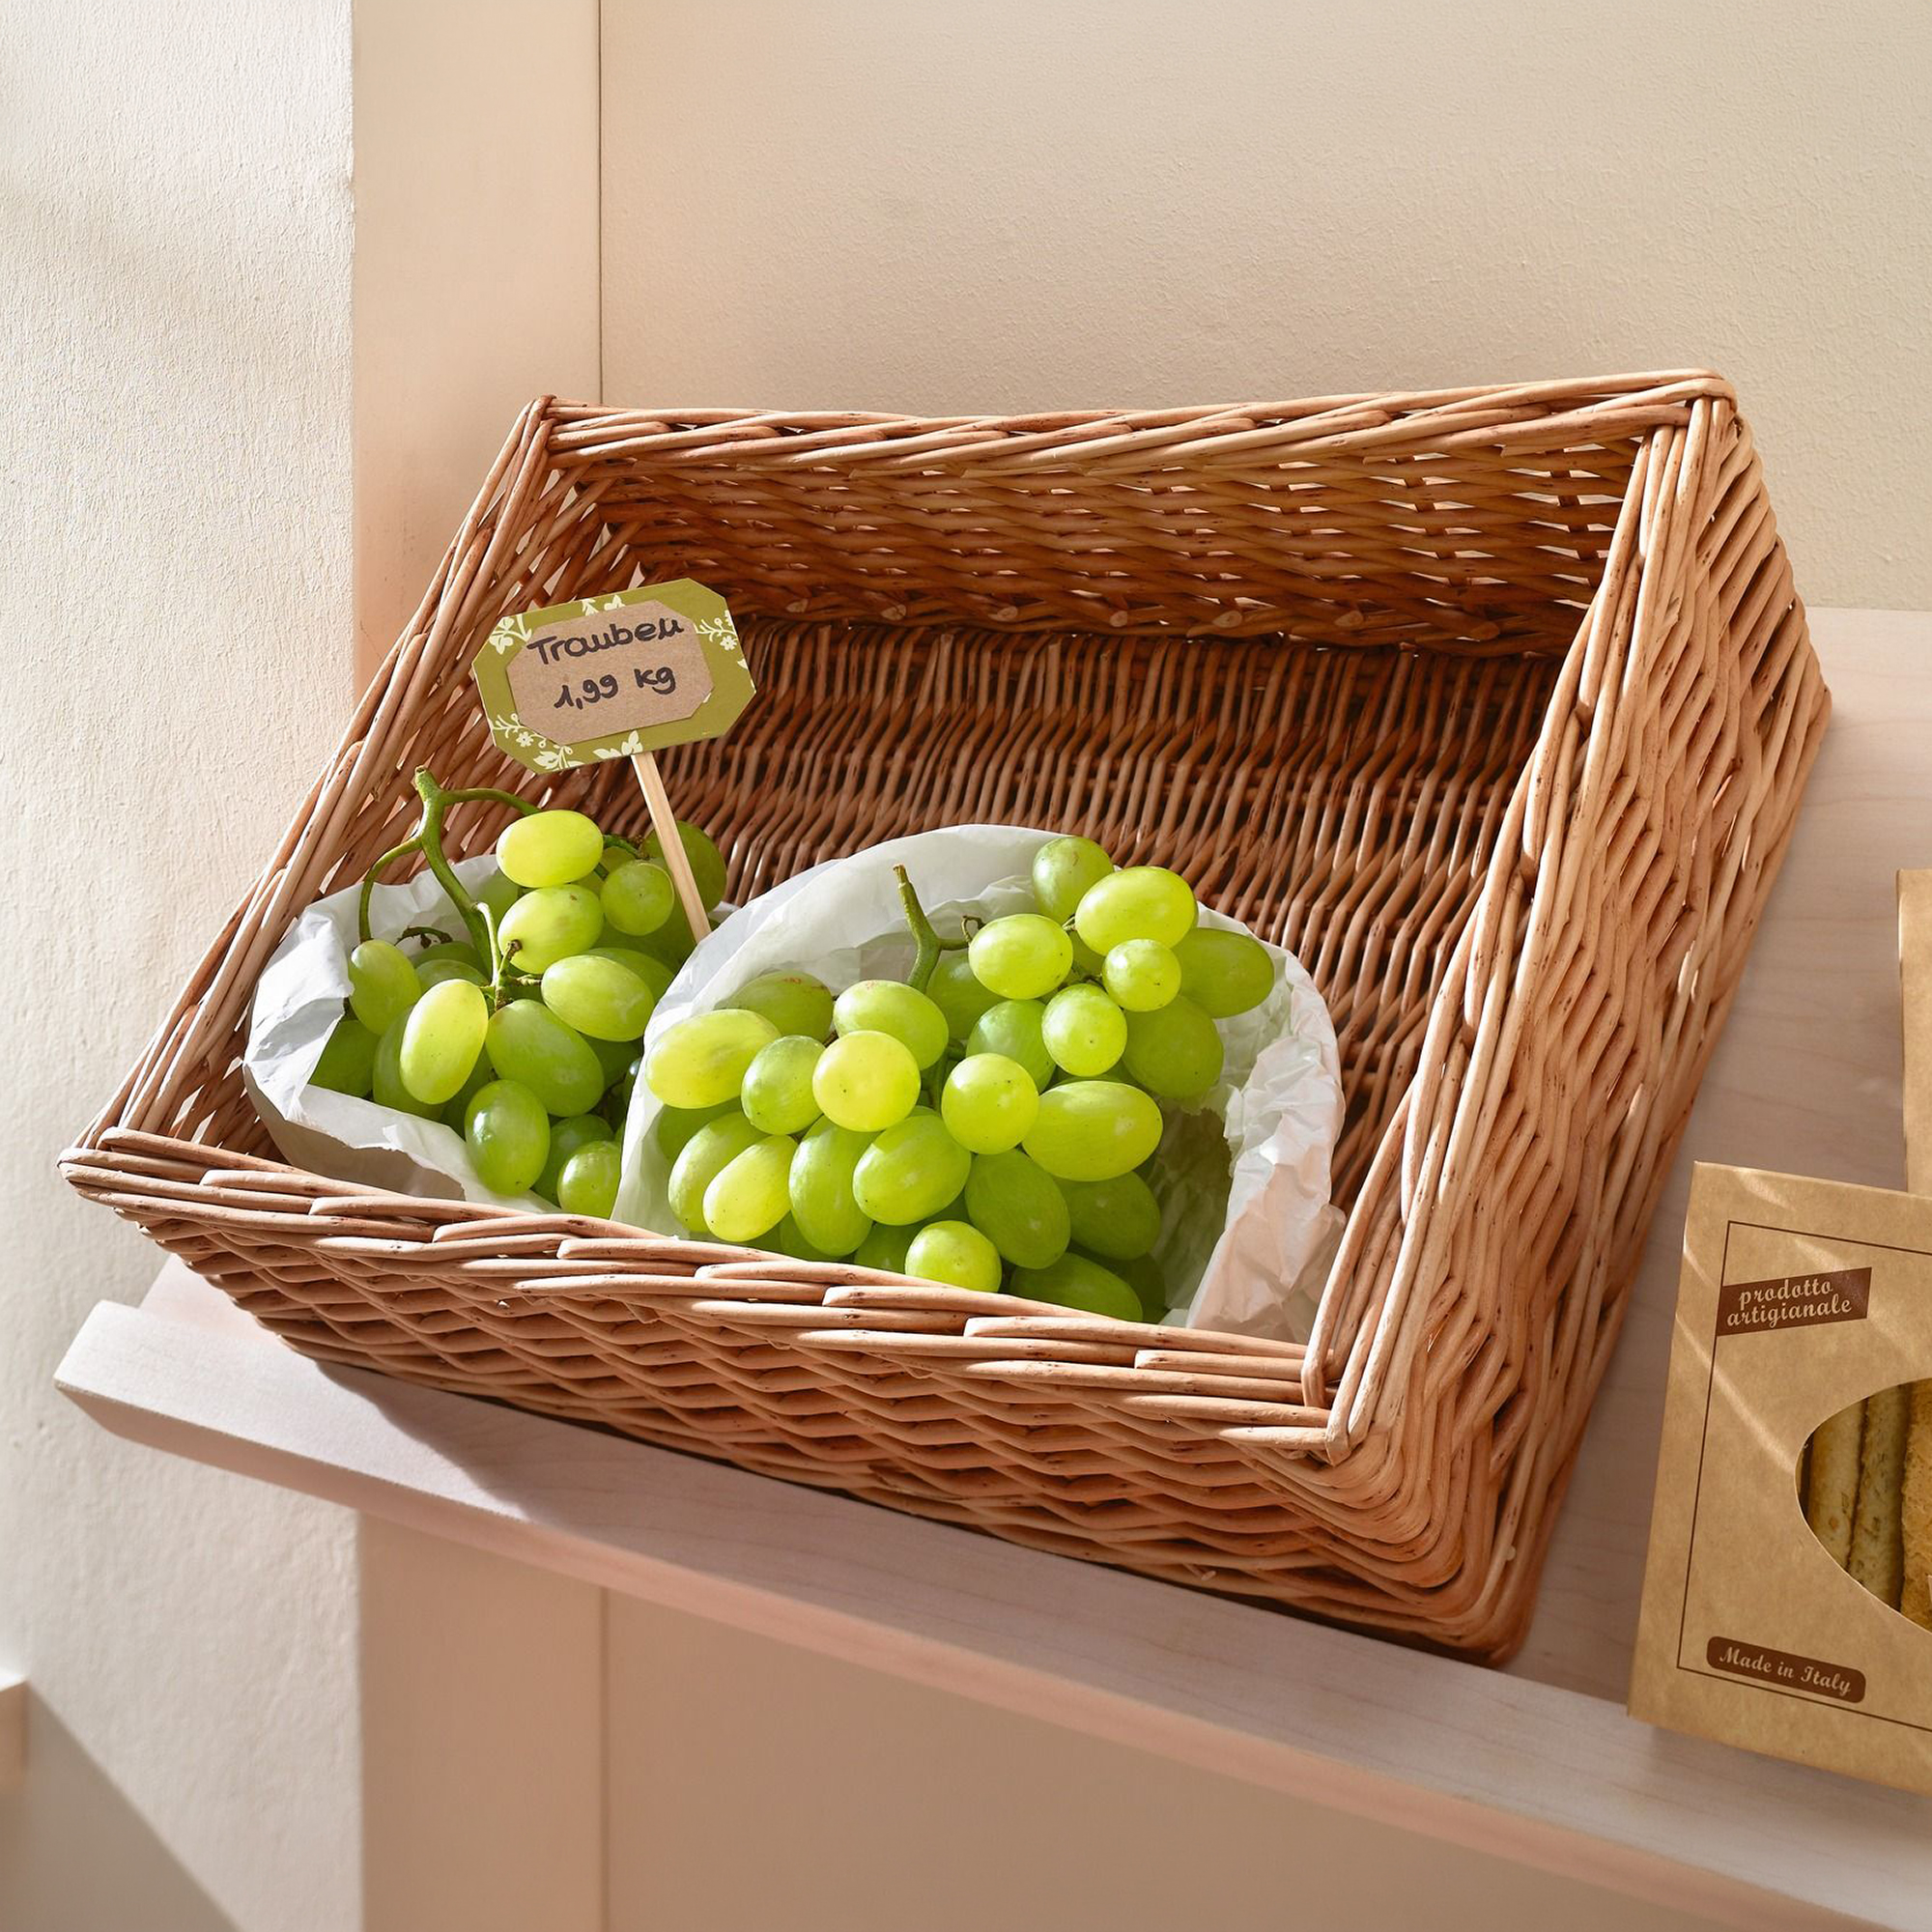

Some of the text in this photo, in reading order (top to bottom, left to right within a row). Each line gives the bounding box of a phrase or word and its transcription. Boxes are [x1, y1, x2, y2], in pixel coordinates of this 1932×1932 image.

[527, 617, 684, 665] Trauben
[554, 667, 676, 710] 1,99 kg
[1727, 1293, 1852, 1328] artigianale
[1739, 1279, 1833, 1311] prodotto
[1719, 1646, 1851, 1696] Made in Italy
